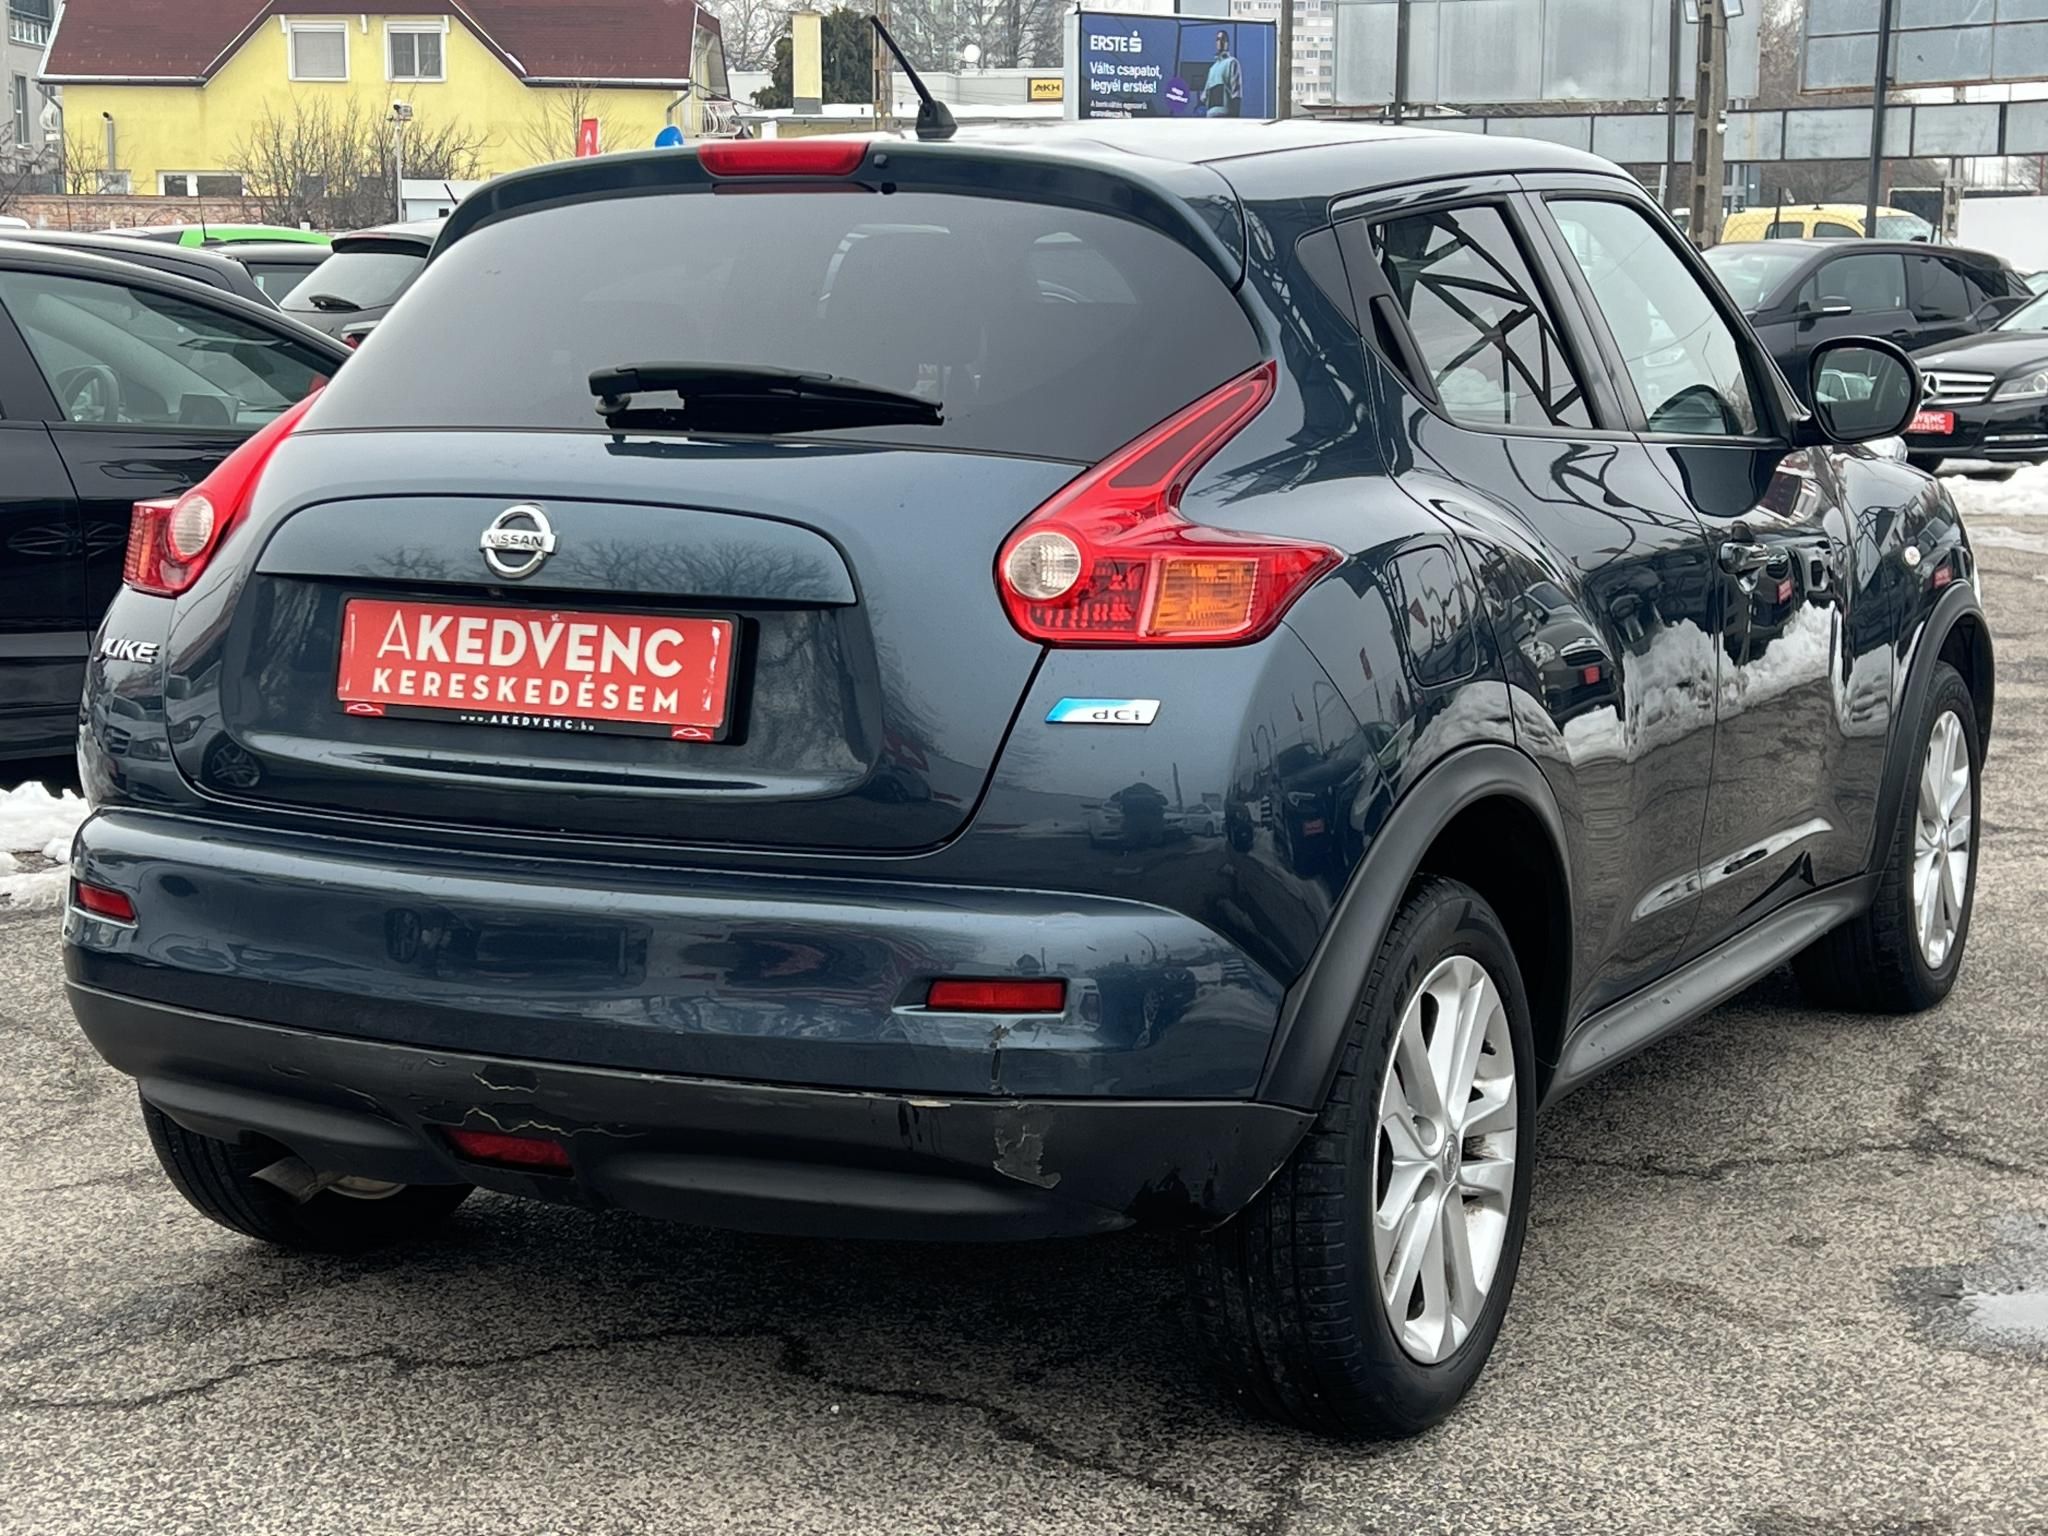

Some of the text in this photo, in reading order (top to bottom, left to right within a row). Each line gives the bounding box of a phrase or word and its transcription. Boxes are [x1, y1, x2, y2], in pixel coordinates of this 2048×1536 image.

[1090, 34, 1129, 52] ERSTE
[1090, 61, 1163, 80] Válts csapatot,
[1091, 78, 1121, 94] legyél
[1122, 81, 1157, 94] erstés!
[487, 533, 545, 547] NISSAN
[376, 609, 685, 678] AKEDVENC
[372, 667, 679, 714] KERESKEDÉSEM
